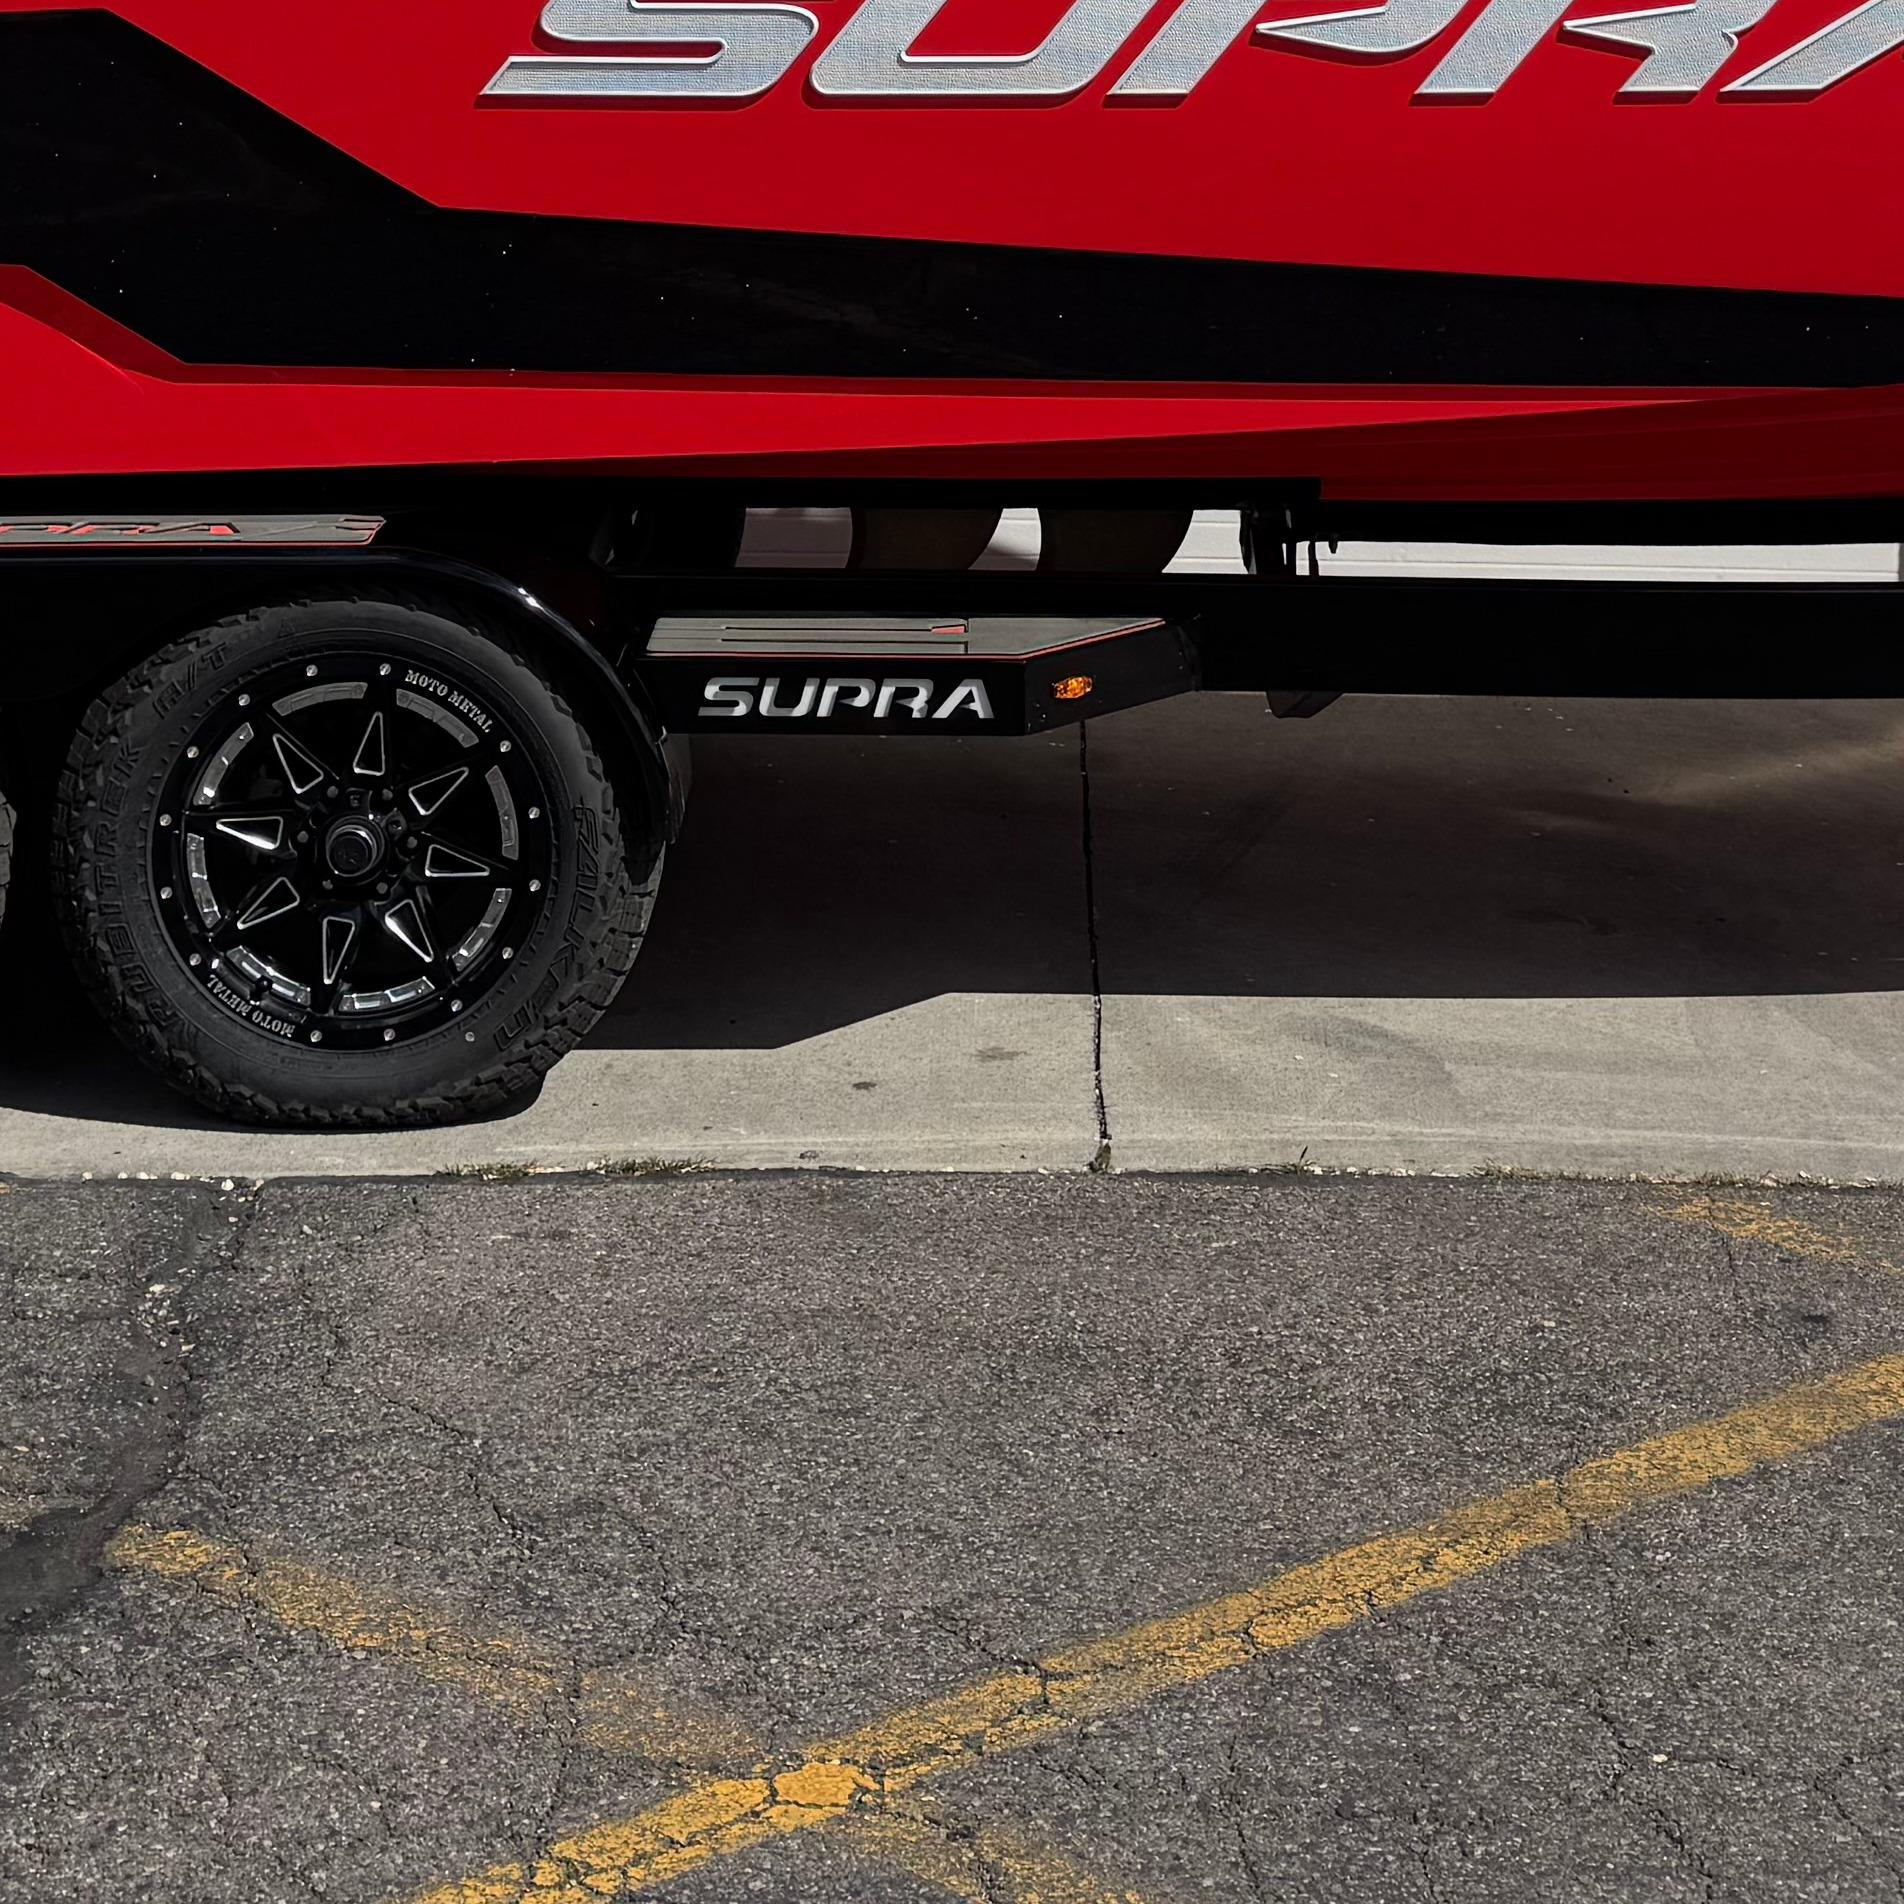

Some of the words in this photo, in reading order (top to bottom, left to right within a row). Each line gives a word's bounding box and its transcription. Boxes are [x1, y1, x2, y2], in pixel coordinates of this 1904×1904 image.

[403, 667, 450, 700] MOTO
[446, 689, 493, 735] METAL
[697, 676, 996, 720] SUPRA
[206, 973, 256, 1020] METAL
[248, 1006, 297, 1040] MOTO
